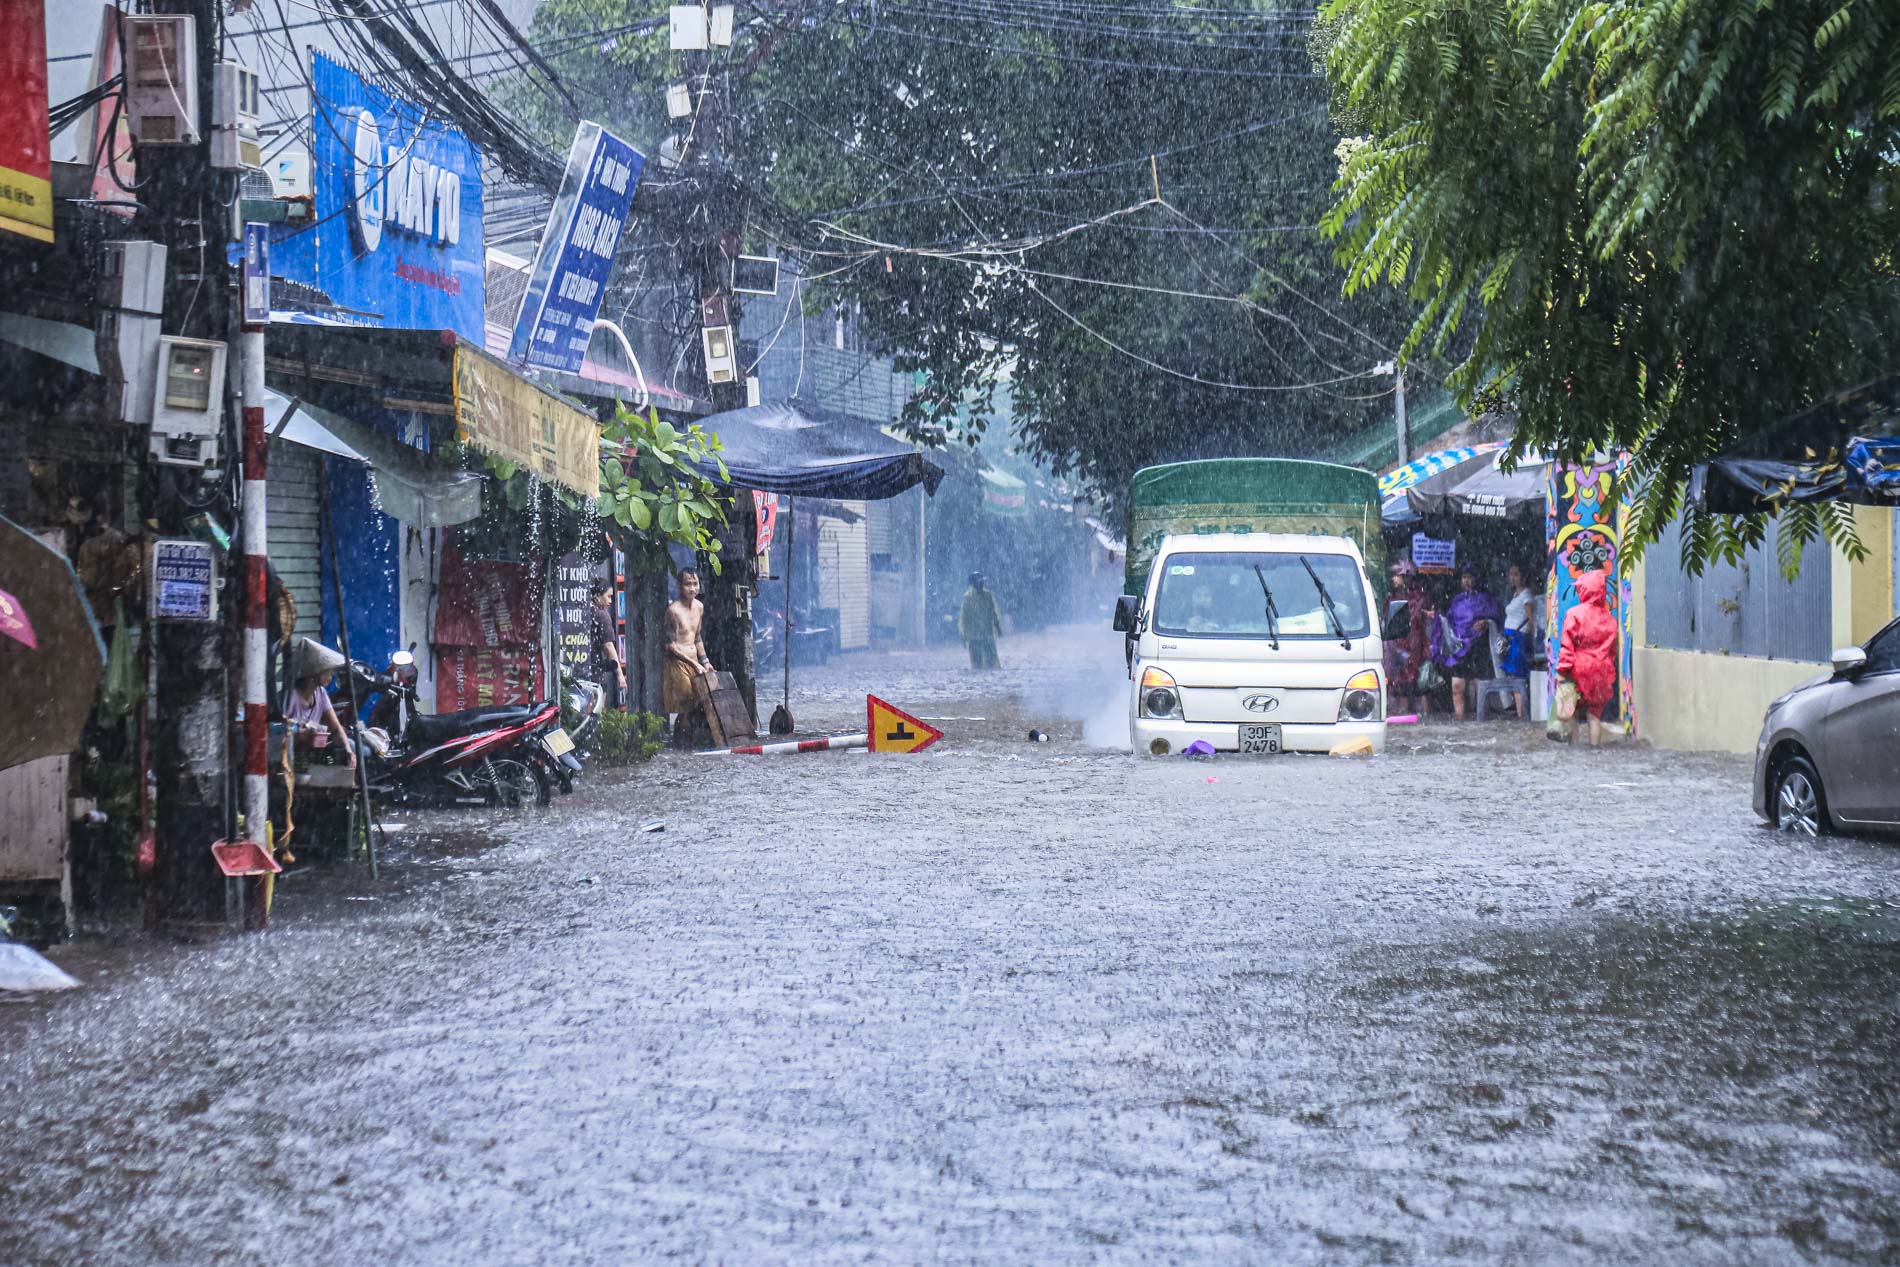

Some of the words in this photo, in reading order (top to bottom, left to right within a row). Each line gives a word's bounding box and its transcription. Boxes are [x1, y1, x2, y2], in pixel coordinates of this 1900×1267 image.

[571, 203, 602, 258] NGỌC
[592, 207, 622, 260] BÁCH
[1247, 726, 1272, 740] 30F
[1244, 739, 1277, 753] 2478
